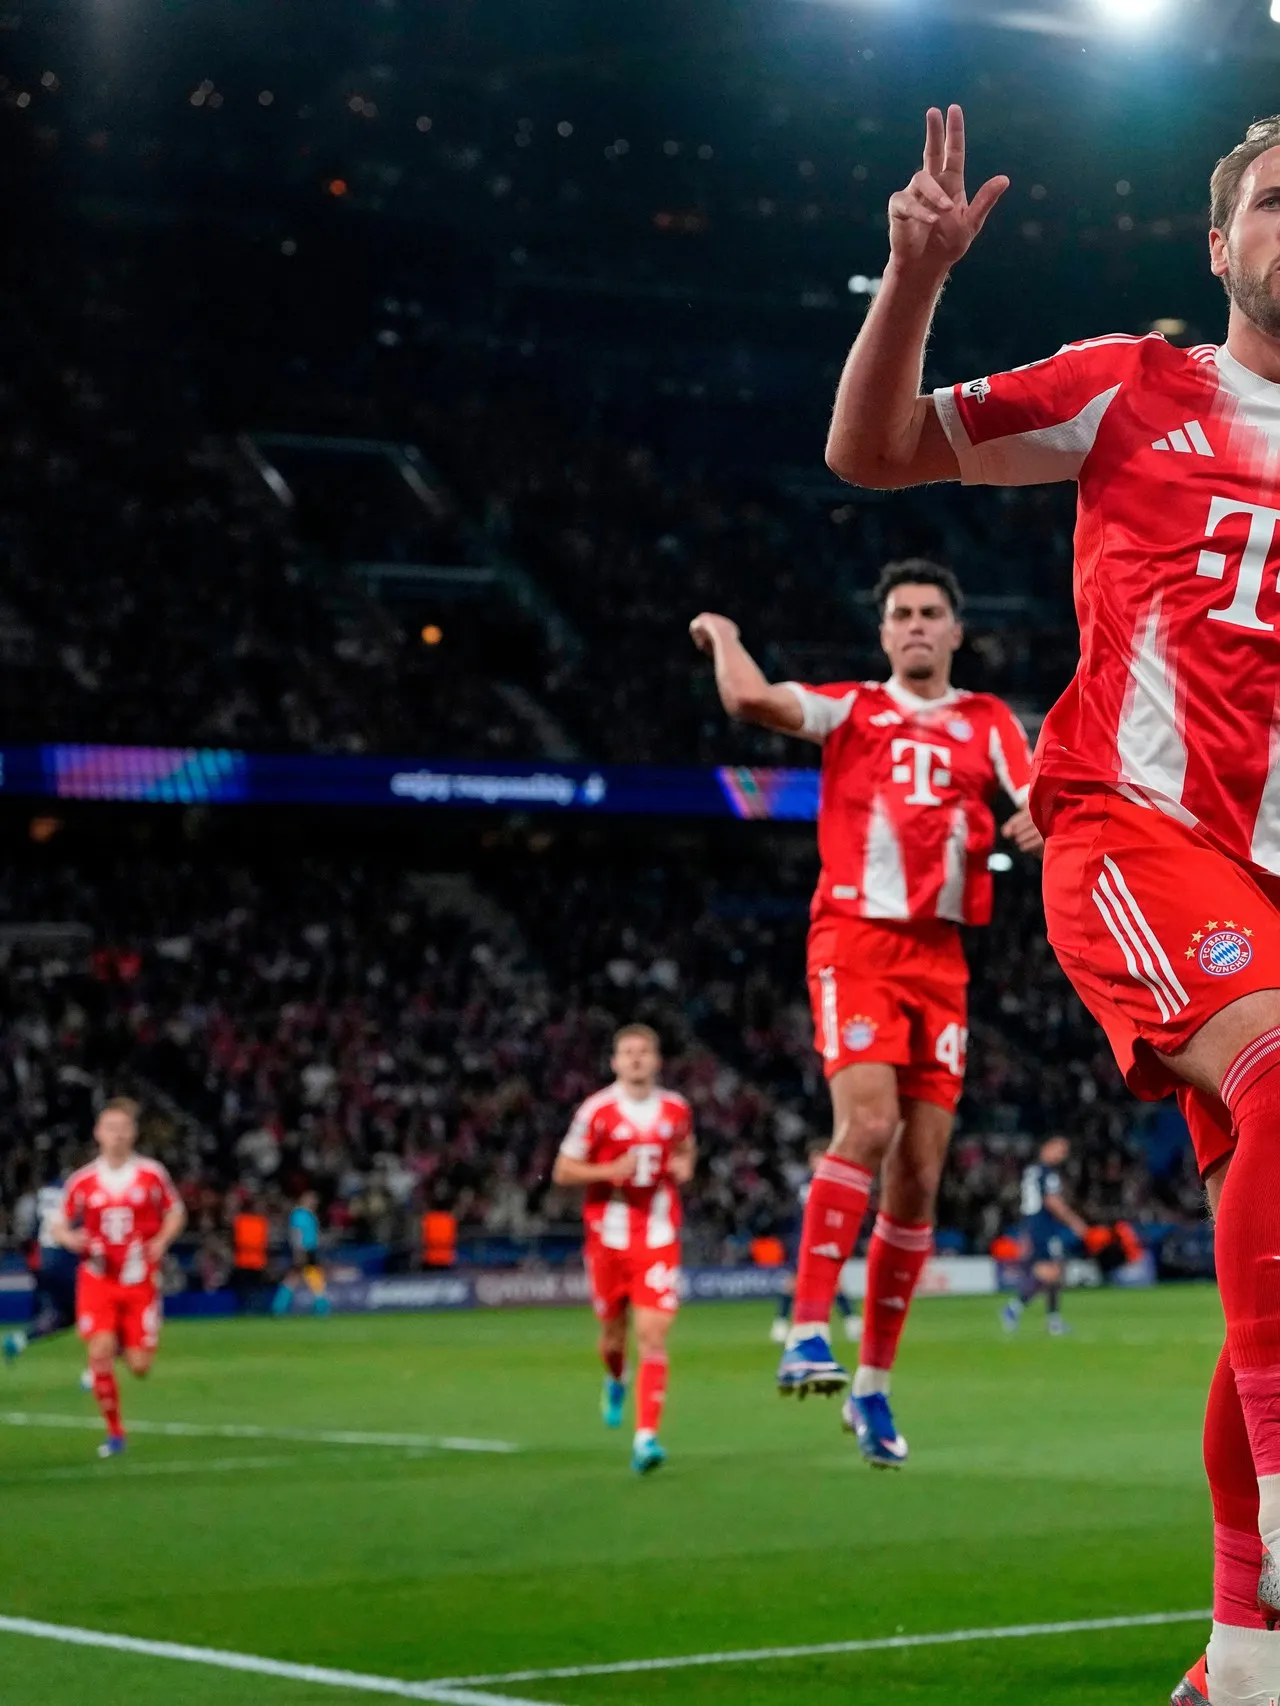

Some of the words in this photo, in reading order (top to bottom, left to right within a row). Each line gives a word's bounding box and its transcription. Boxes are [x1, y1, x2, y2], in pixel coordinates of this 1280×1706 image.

[890, 737, 952, 807] T
[1202, 947, 1211, 959] FC
[1207, 934, 1245, 947] BAYERN
